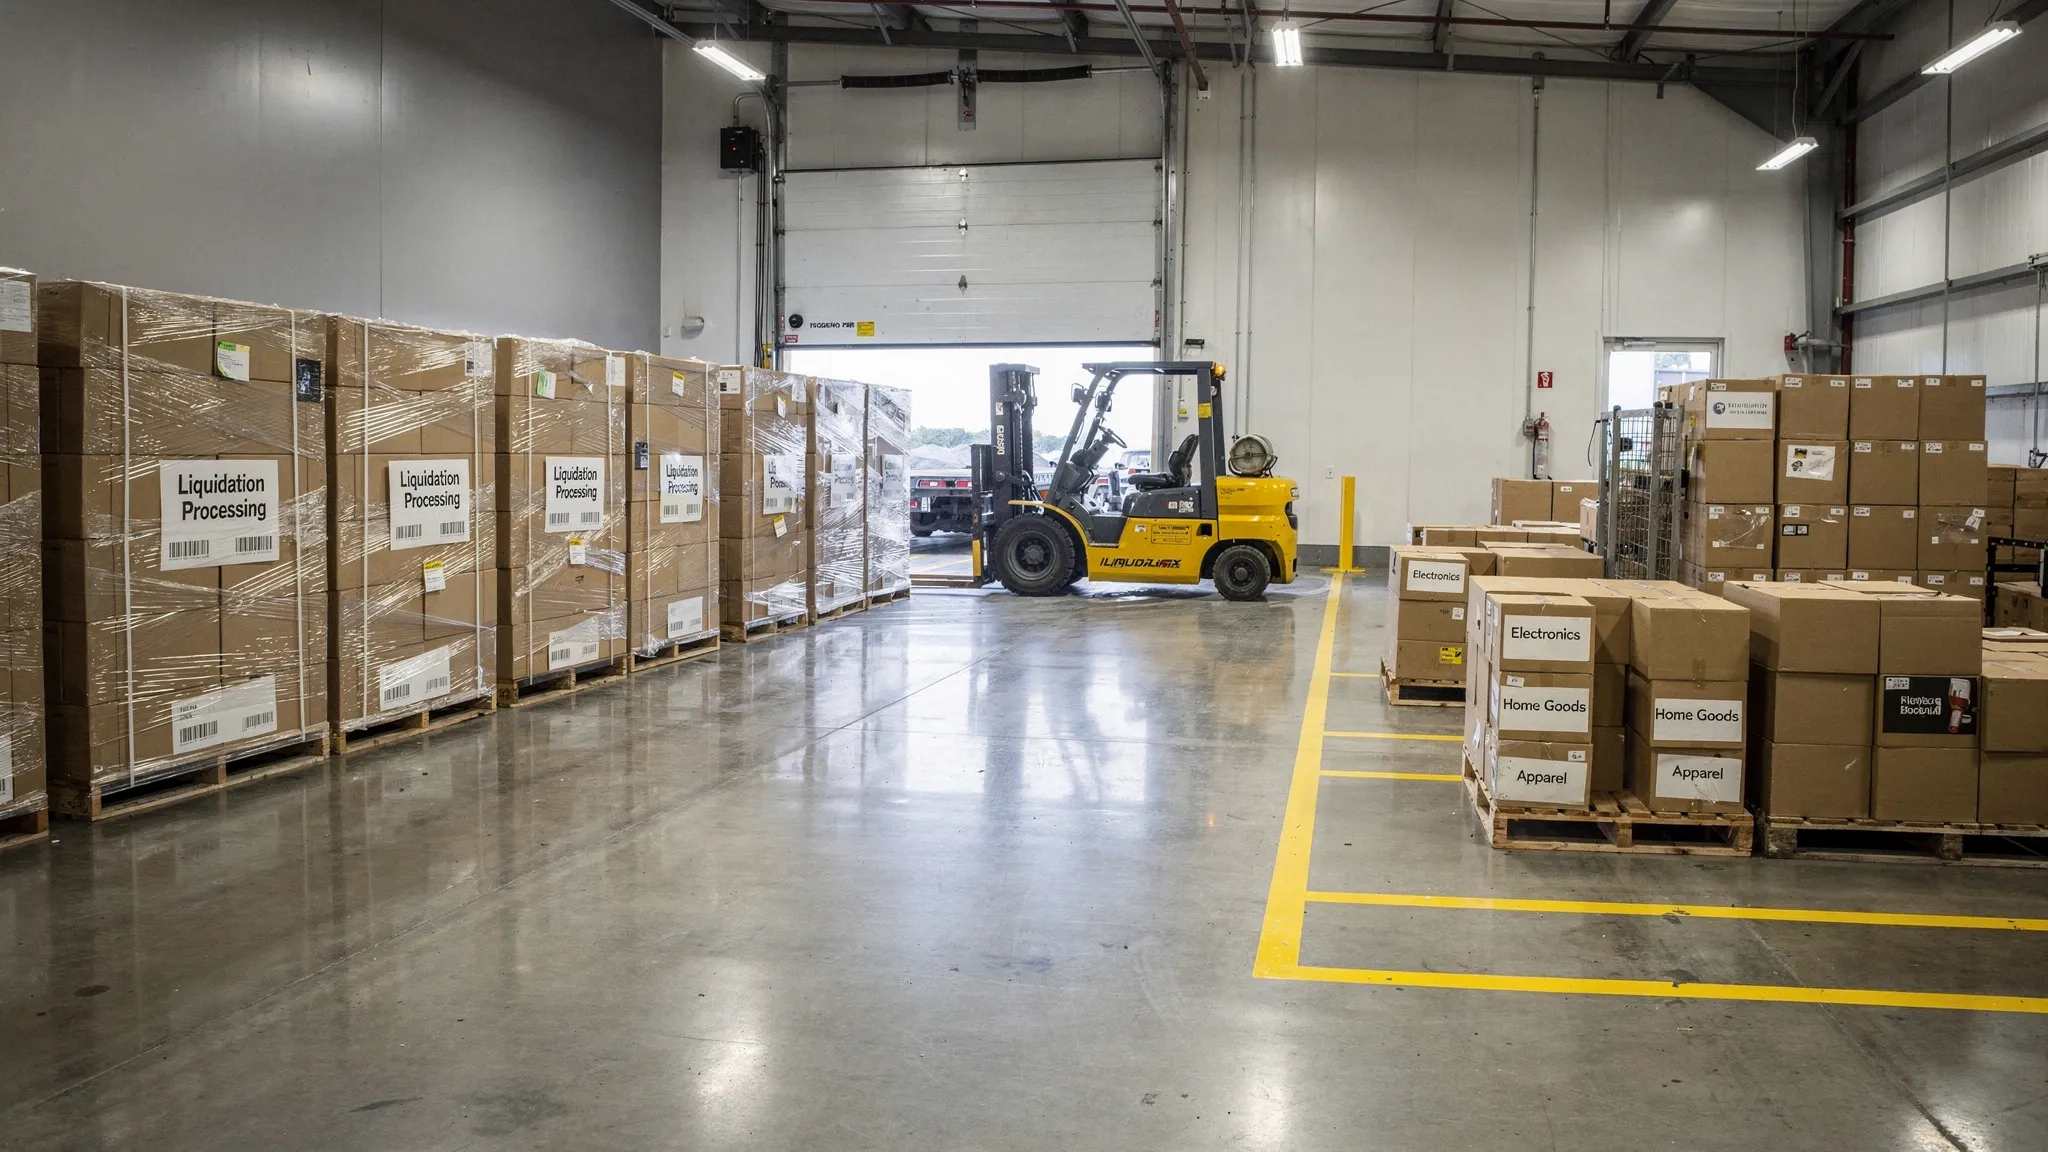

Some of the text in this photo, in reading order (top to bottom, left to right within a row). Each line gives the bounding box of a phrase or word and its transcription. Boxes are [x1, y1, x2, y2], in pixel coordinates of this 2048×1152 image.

[400, 469, 460, 491] Liquidation
[554, 466, 598, 484] Liquidation
[178, 473, 265, 499] Liquidation
[556, 484, 598, 502] Processing
[404, 490, 460, 510] Processing
[182, 498, 267, 521] Processing
[1413, 569, 1460, 581] Electronics
[1511, 626, 1581, 640] Electronics
[1503, 698, 1587, 713] Home Goods
[1655, 708, 1739, 722] Home Goods
[1517, 769, 1568, 785] Apparel
[1672, 765, 1724, 781] Apparel
